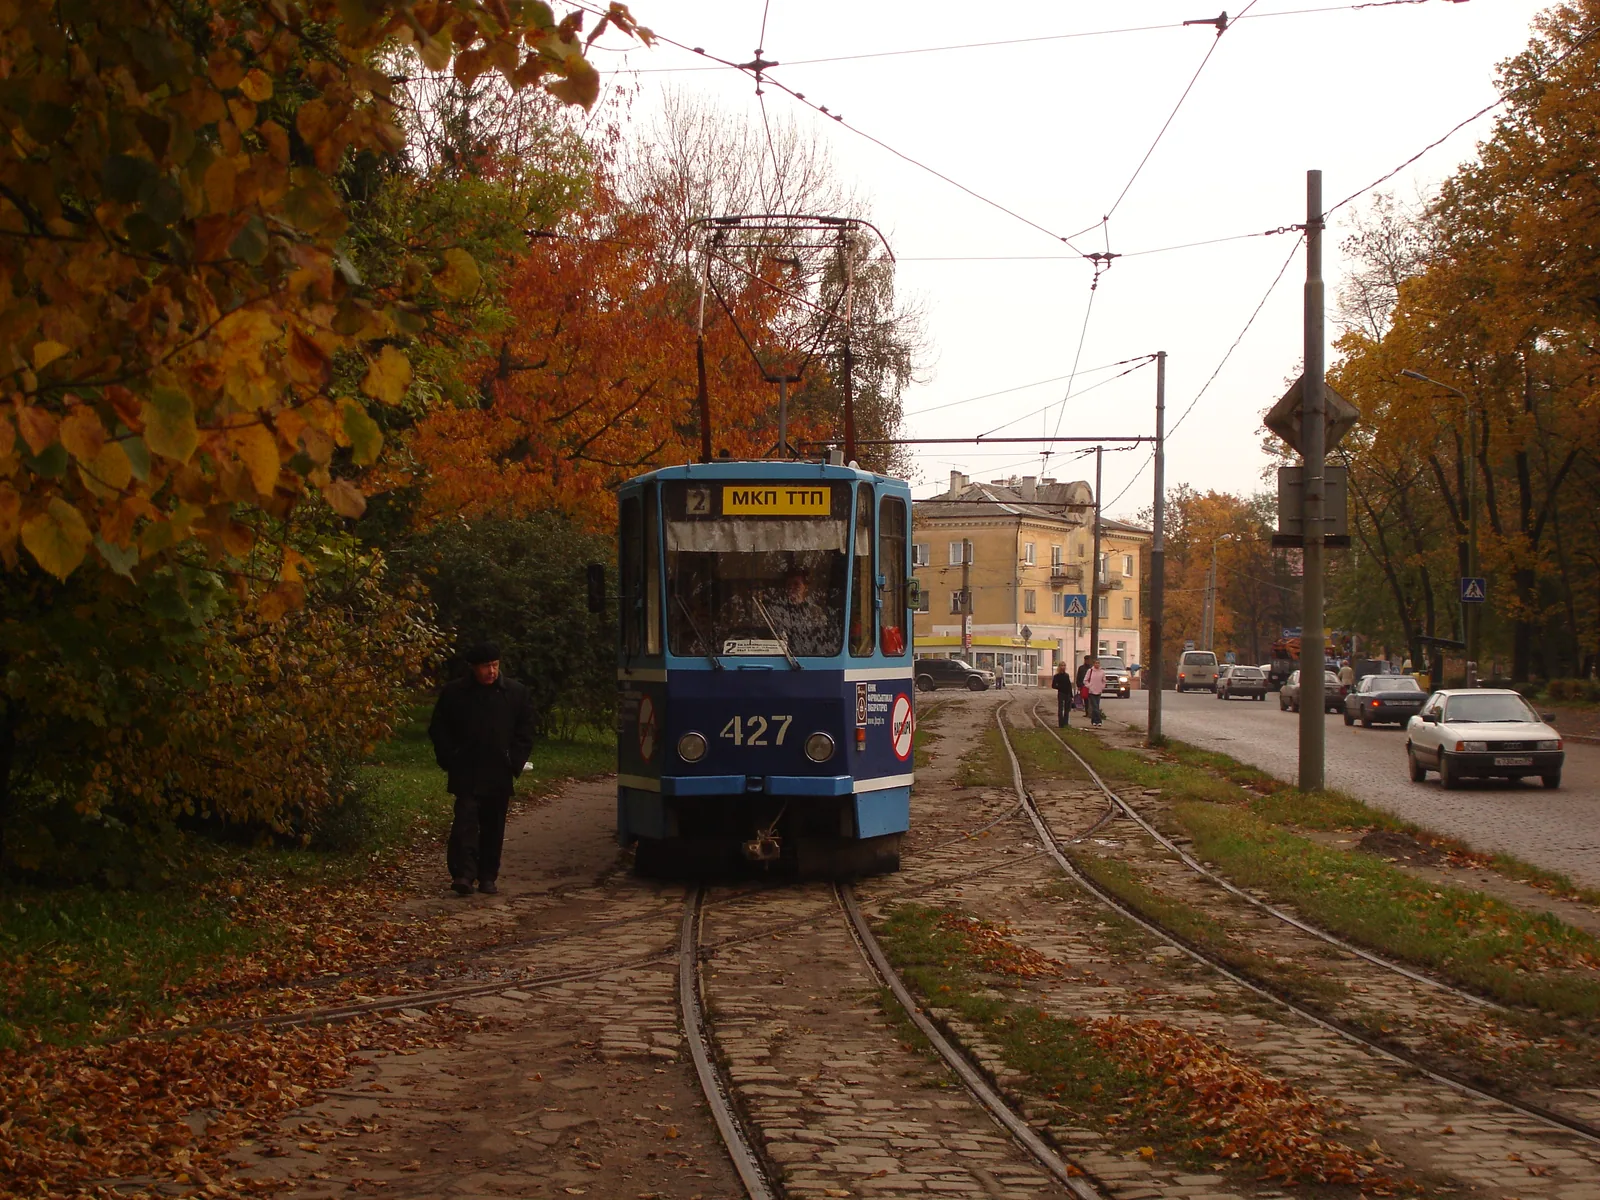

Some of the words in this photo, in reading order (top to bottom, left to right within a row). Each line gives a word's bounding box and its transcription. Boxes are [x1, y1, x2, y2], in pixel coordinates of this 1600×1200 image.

[692, 490, 706, 511] 2
[732, 491, 777, 505] МКП
[785, 491, 823, 505] ТТП
[725, 642, 736, 653] 2
[720, 715, 793, 745] 427
